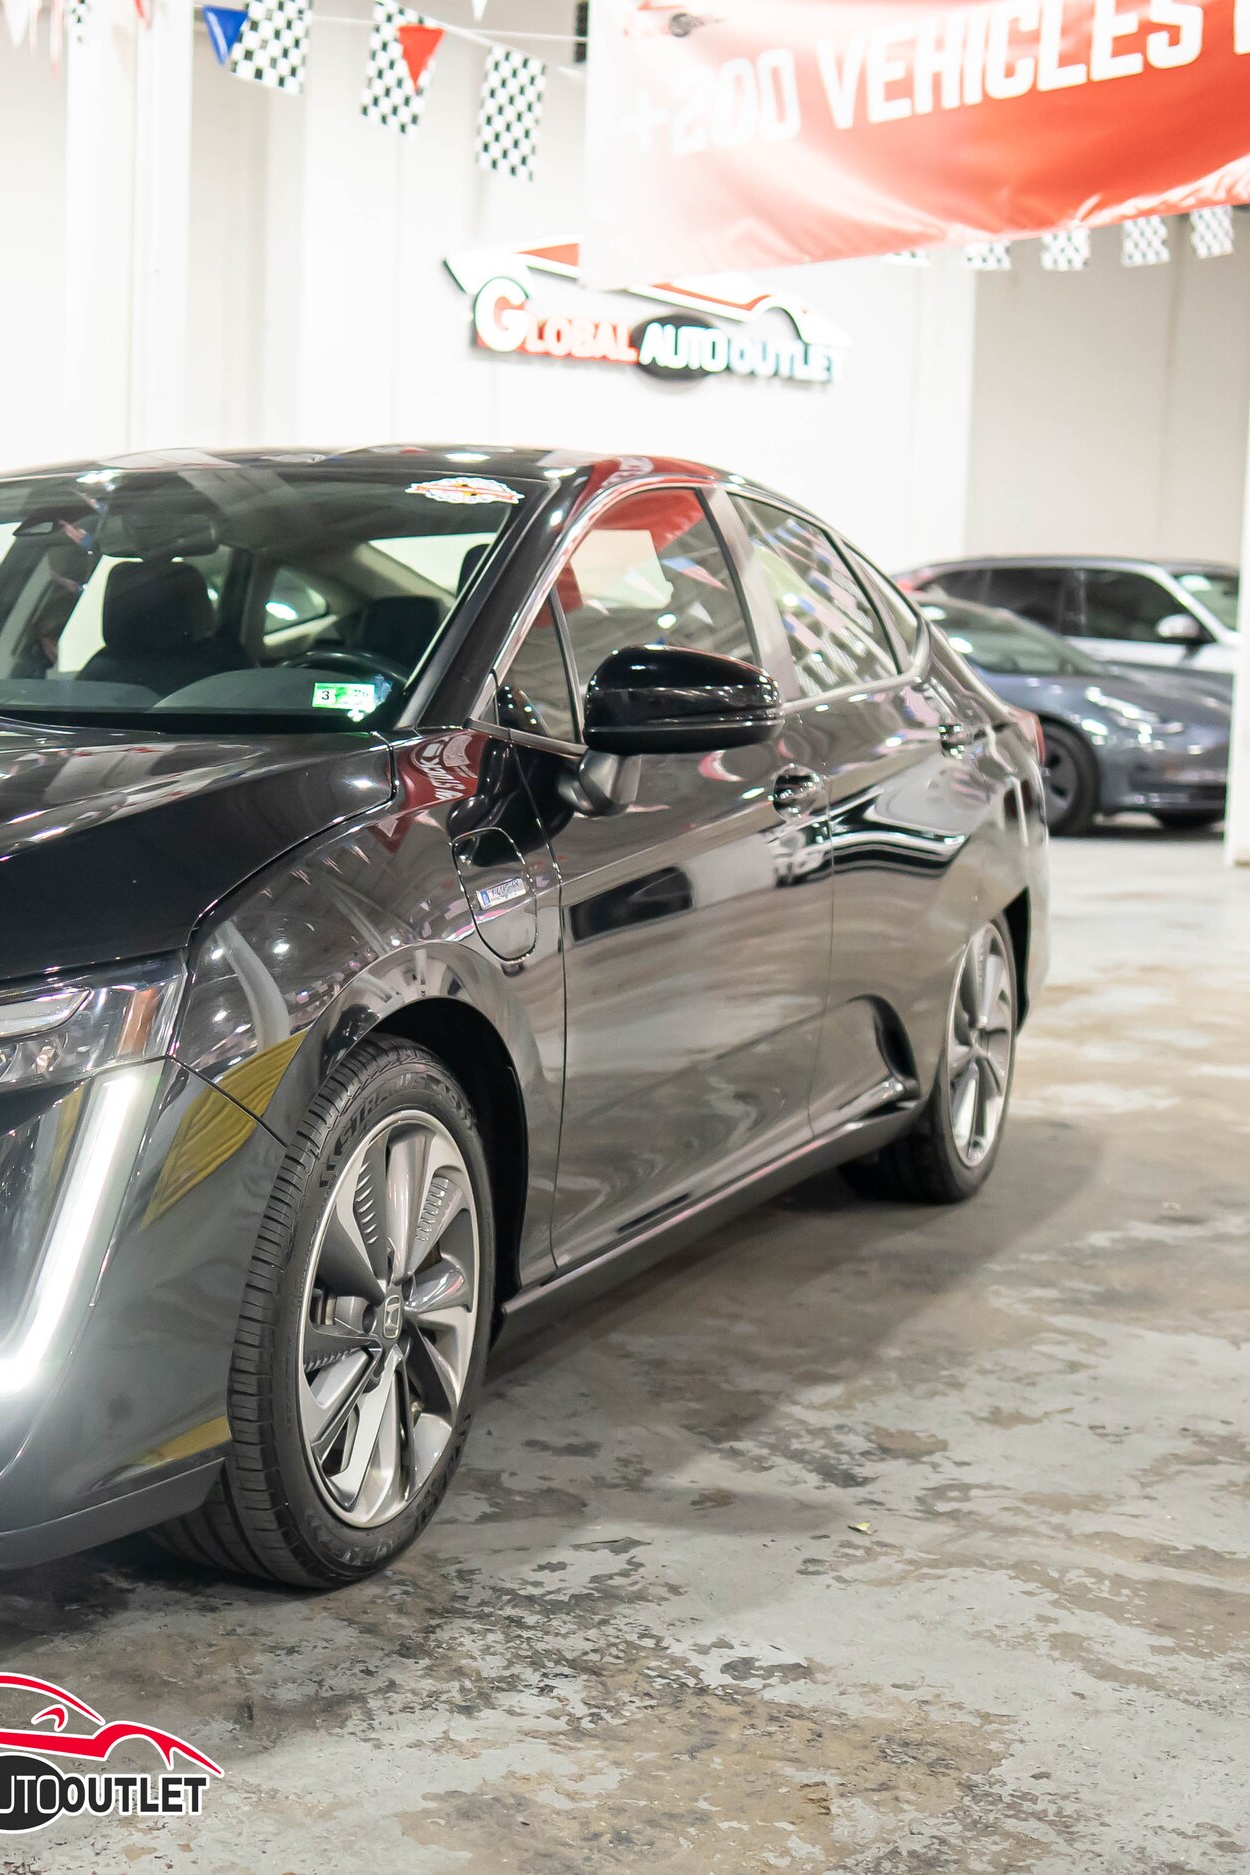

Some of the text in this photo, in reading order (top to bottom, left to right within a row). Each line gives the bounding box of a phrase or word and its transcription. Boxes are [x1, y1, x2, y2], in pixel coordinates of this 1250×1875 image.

[816, 0, 1203, 130] VEHICLES
[475, 276, 834, 382] GLOBAL AUTO OUTLET
